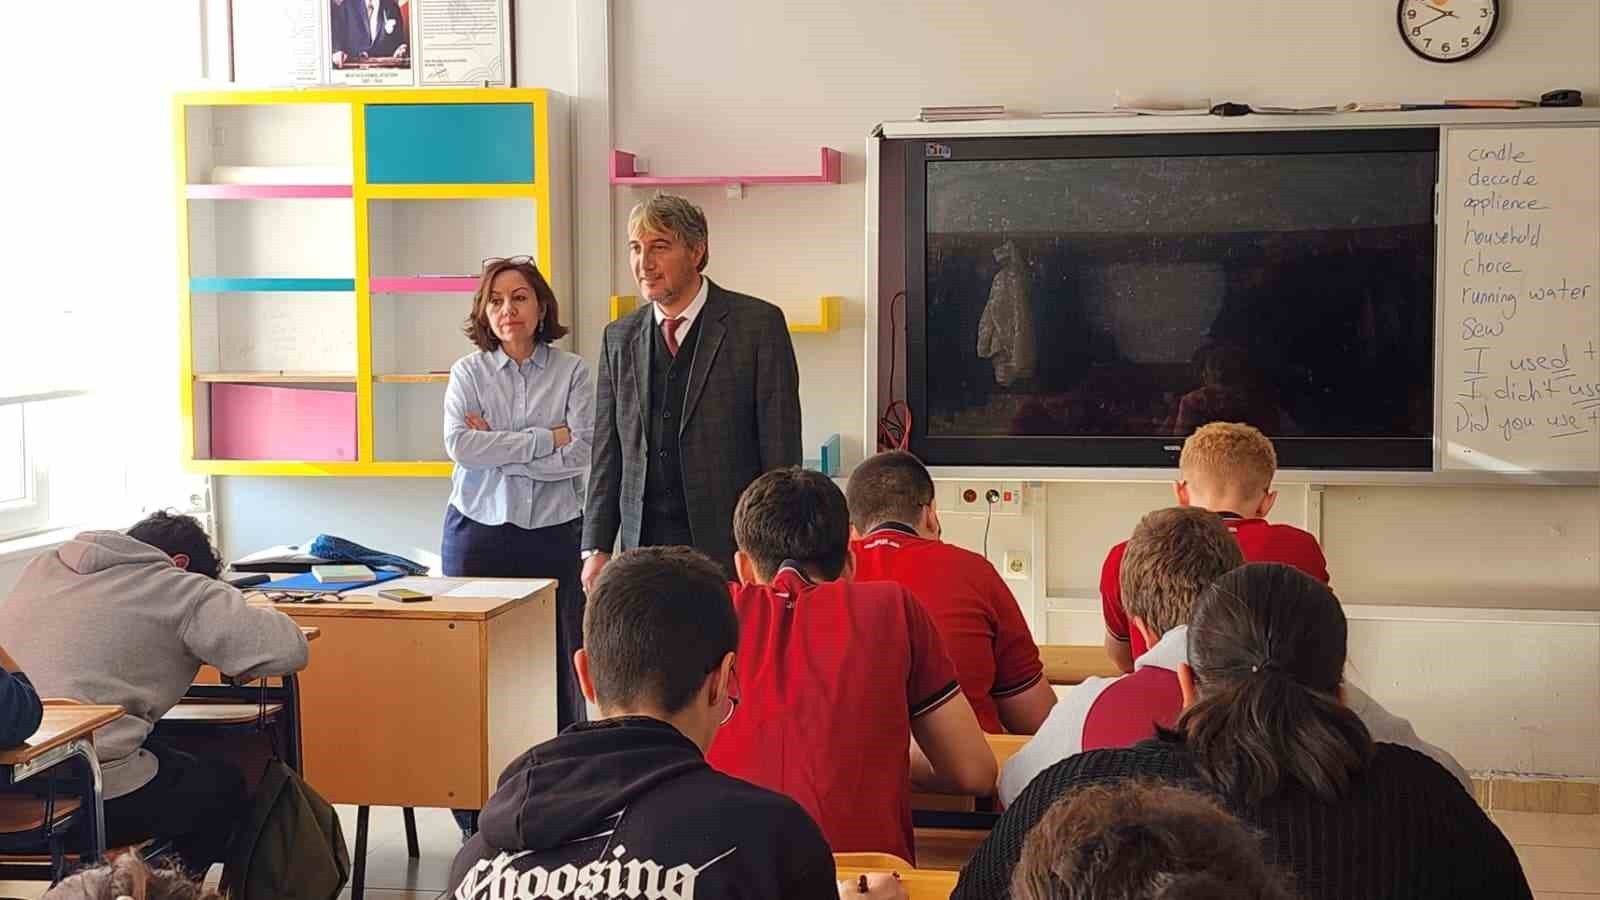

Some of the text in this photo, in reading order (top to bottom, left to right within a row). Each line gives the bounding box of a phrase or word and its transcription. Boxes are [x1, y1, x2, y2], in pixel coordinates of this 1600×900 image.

[1407, 9, 1417, 20] 9
[1480, 8, 1489, 18] 3
[1473, 26, 1482, 36] 4
[1423, 38, 1433, 49] 7
[1441, 42, 1451, 53] 6
[1461, 37, 1470, 48] 5
[1468, 167, 1537, 186] decade
[1464, 220, 1542, 249] household
[1461, 278, 1592, 320] running water
[1509, 343, 1569, 371] used
[1456, 401, 1490, 433] Did
[1499, 417, 1535, 441] you
[1546, 412, 1582, 430] use
[454, 846, 700, 900] Choosing
